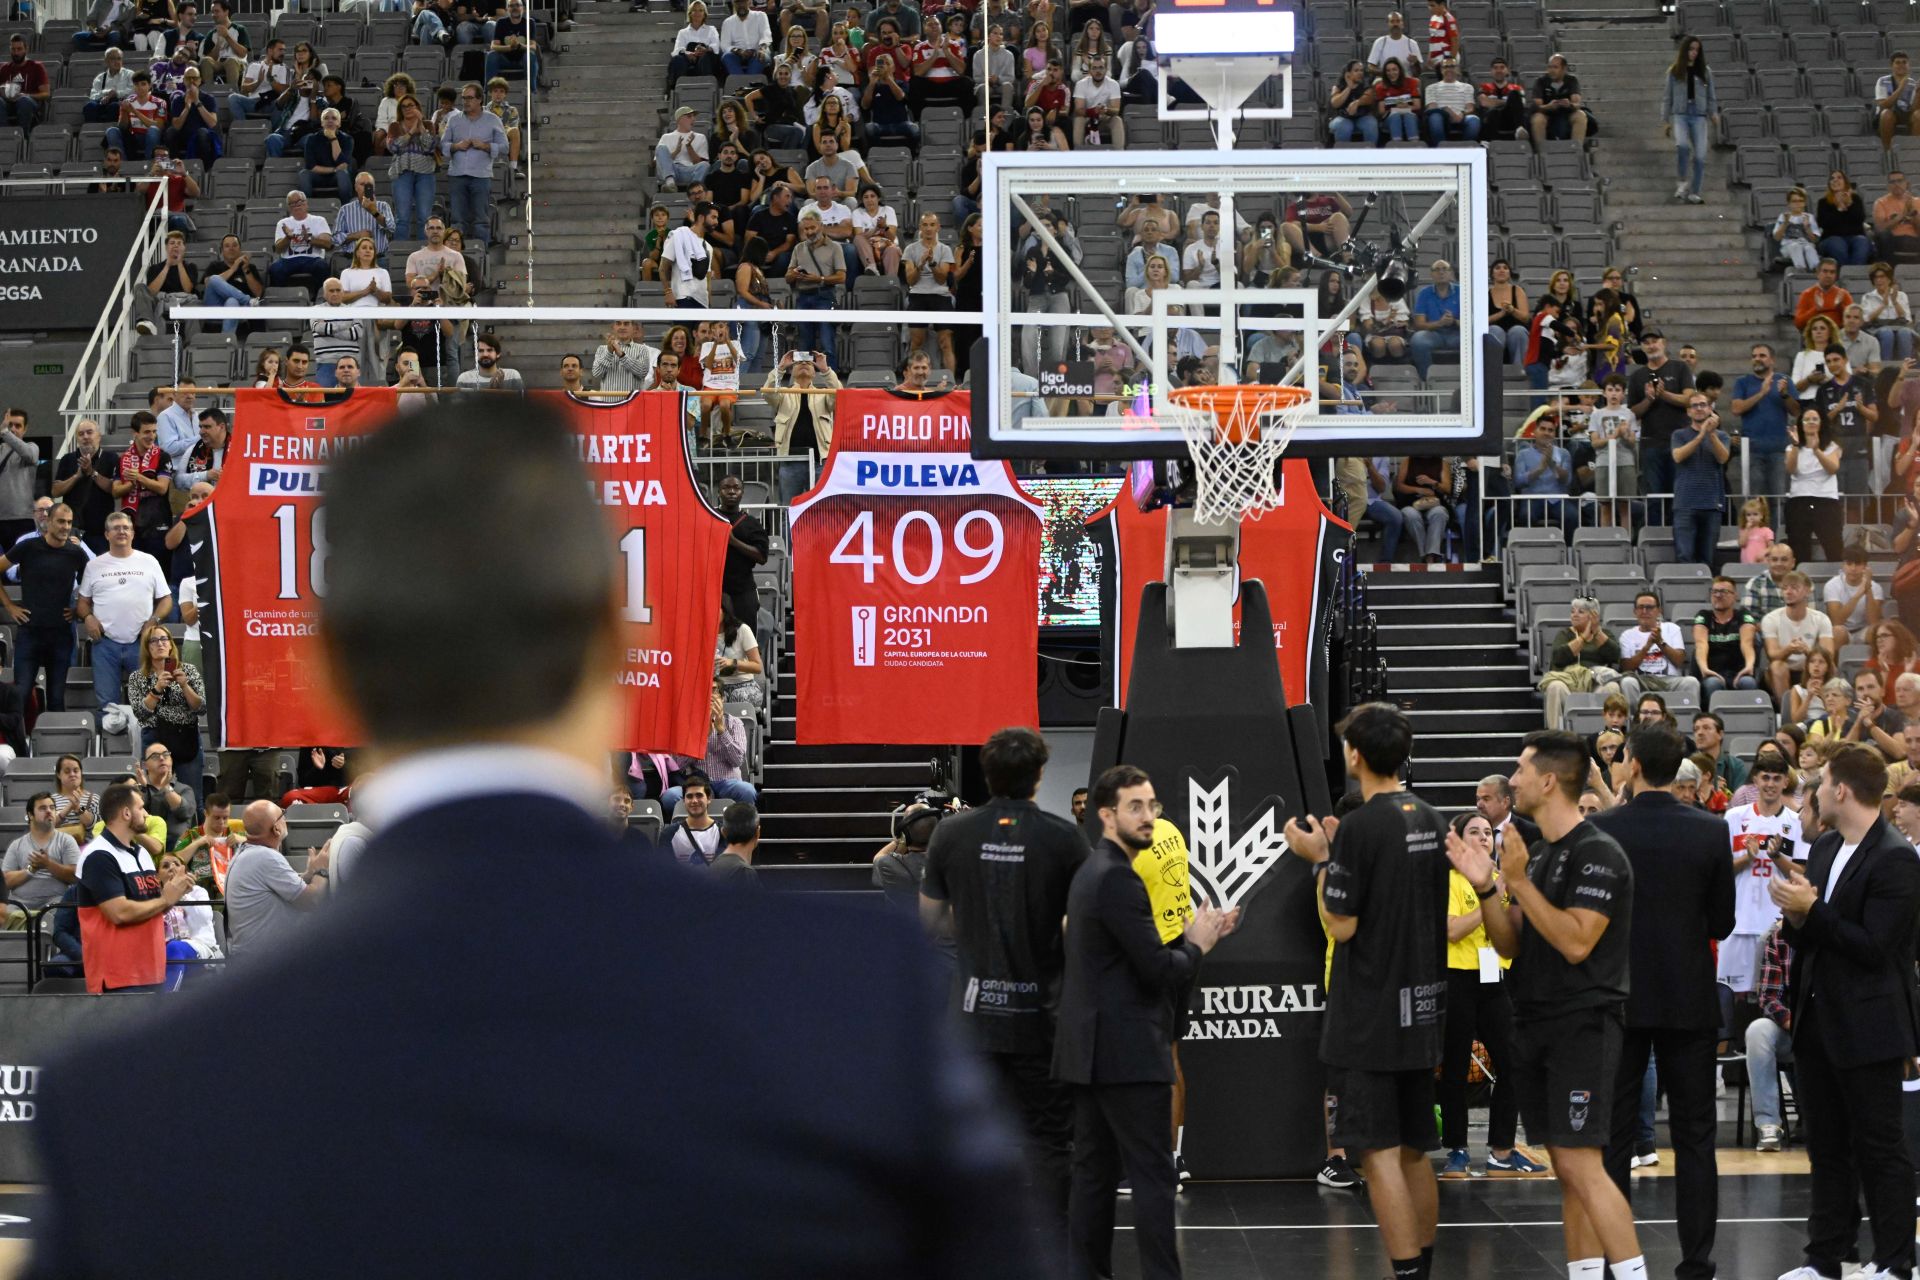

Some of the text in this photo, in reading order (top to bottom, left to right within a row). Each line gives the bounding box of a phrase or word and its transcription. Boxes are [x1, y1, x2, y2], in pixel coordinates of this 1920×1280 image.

[0, 228, 98, 245] AMIENTO
[1041, 371, 1065, 385] liga
[1041, 384, 1093, 395] endesa
[863, 414, 932, 440] PABLO
[1840, 412, 1855, 426] 12
[857, 460, 980, 487] PULEVA
[829, 510, 1004, 585] 409
[243, 609, 252, 619] El
[253, 610, 287, 619] camino
[288, 609, 300, 619] de
[883, 606, 988, 623] GRANADA
[884, 628, 931, 648] 2031
[1151, 835, 1180, 860] STAFF
[1752, 859, 1773, 877] 25
[979, 991, 1008, 1005] 2031
[1201, 984, 1327, 1014] RURAL
[1182, 1018, 1282, 1040] ANADA
